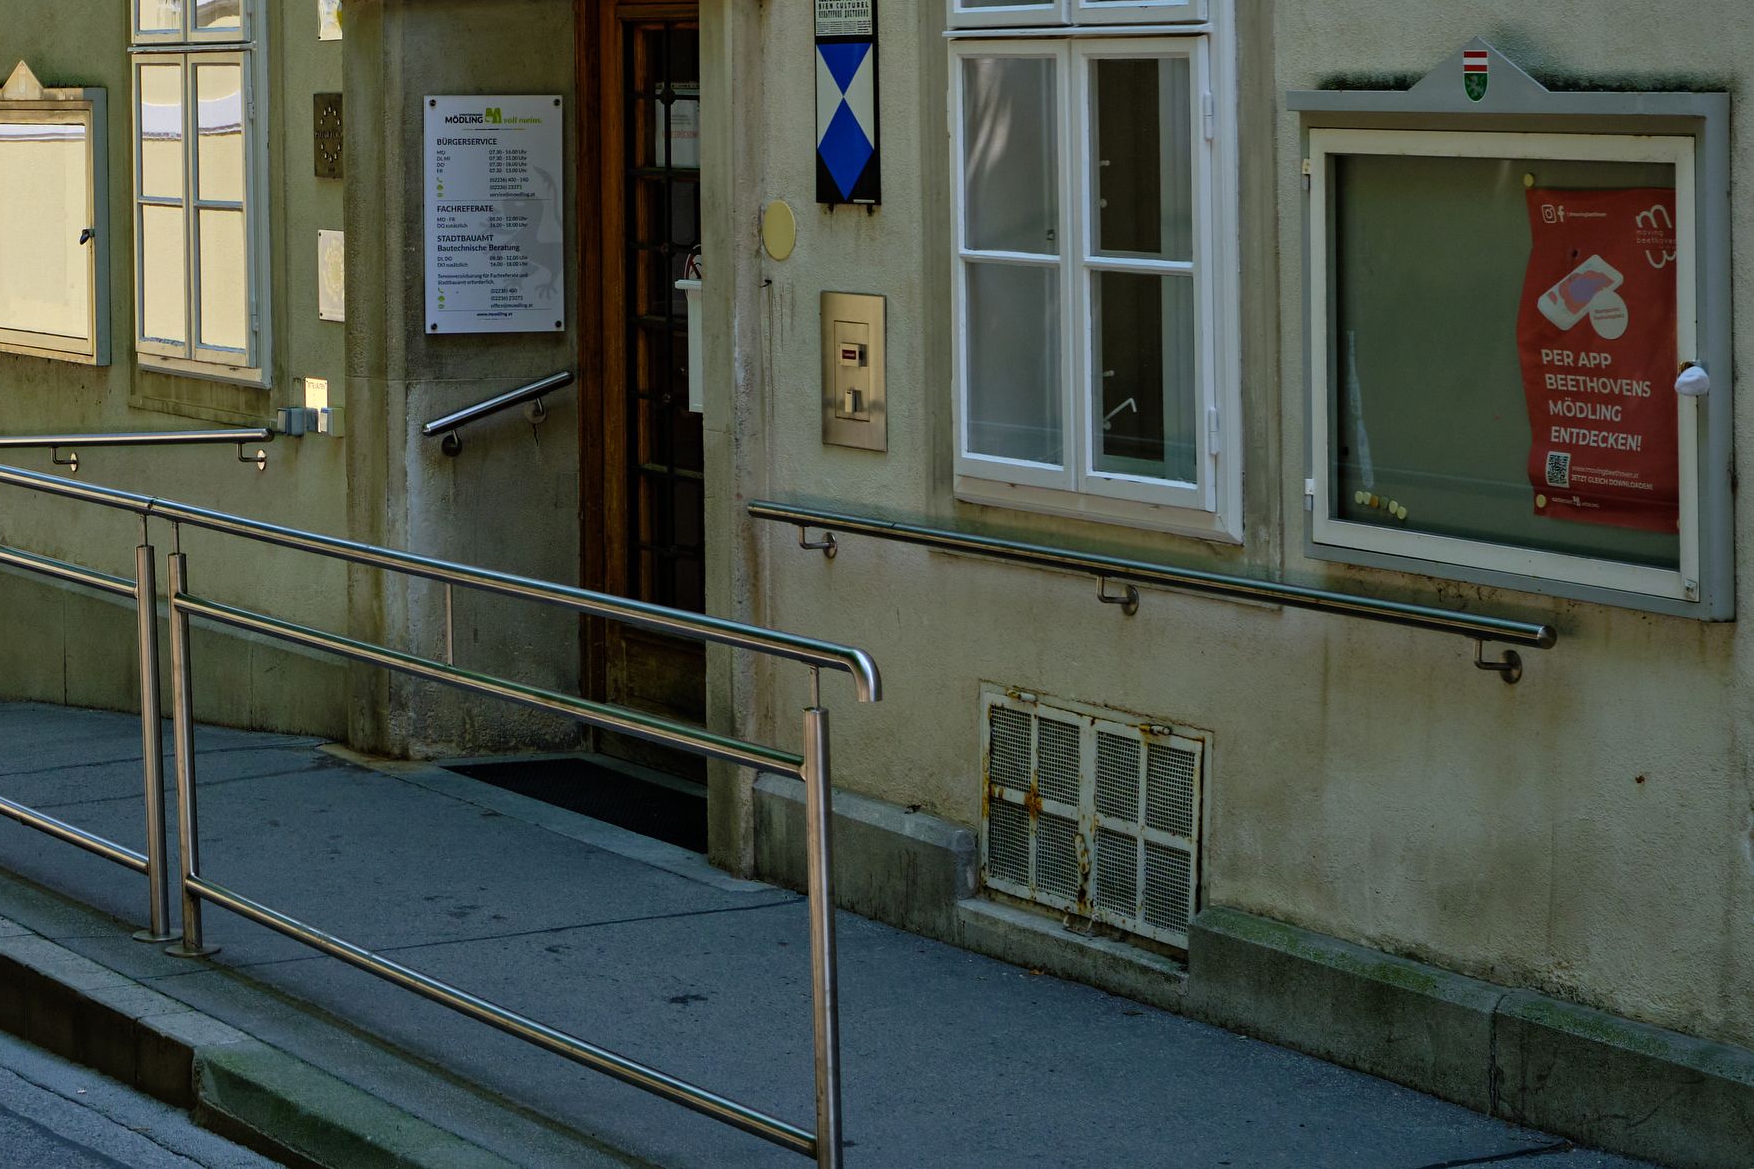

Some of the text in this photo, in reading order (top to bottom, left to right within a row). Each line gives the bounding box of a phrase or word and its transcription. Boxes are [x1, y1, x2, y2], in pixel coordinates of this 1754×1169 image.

[836, 1, 869, 9] CULTUREL
[445, 114, 483, 124] MÖDLING
[436, 137, 497, 145] BÜRGERSERVICE
[437, 205, 494, 213] FACHREFERATE
[437, 244, 520, 253] Bautechnische Beratung
[1541, 349, 1612, 369] PER APP
[1545, 374, 1652, 397] BEETHOVENS
[1548, 397, 1622, 422] MÖDLING
[1550, 426, 1642, 451] ENTDECKEN!
[1571, 474, 1587, 483] JETZT
